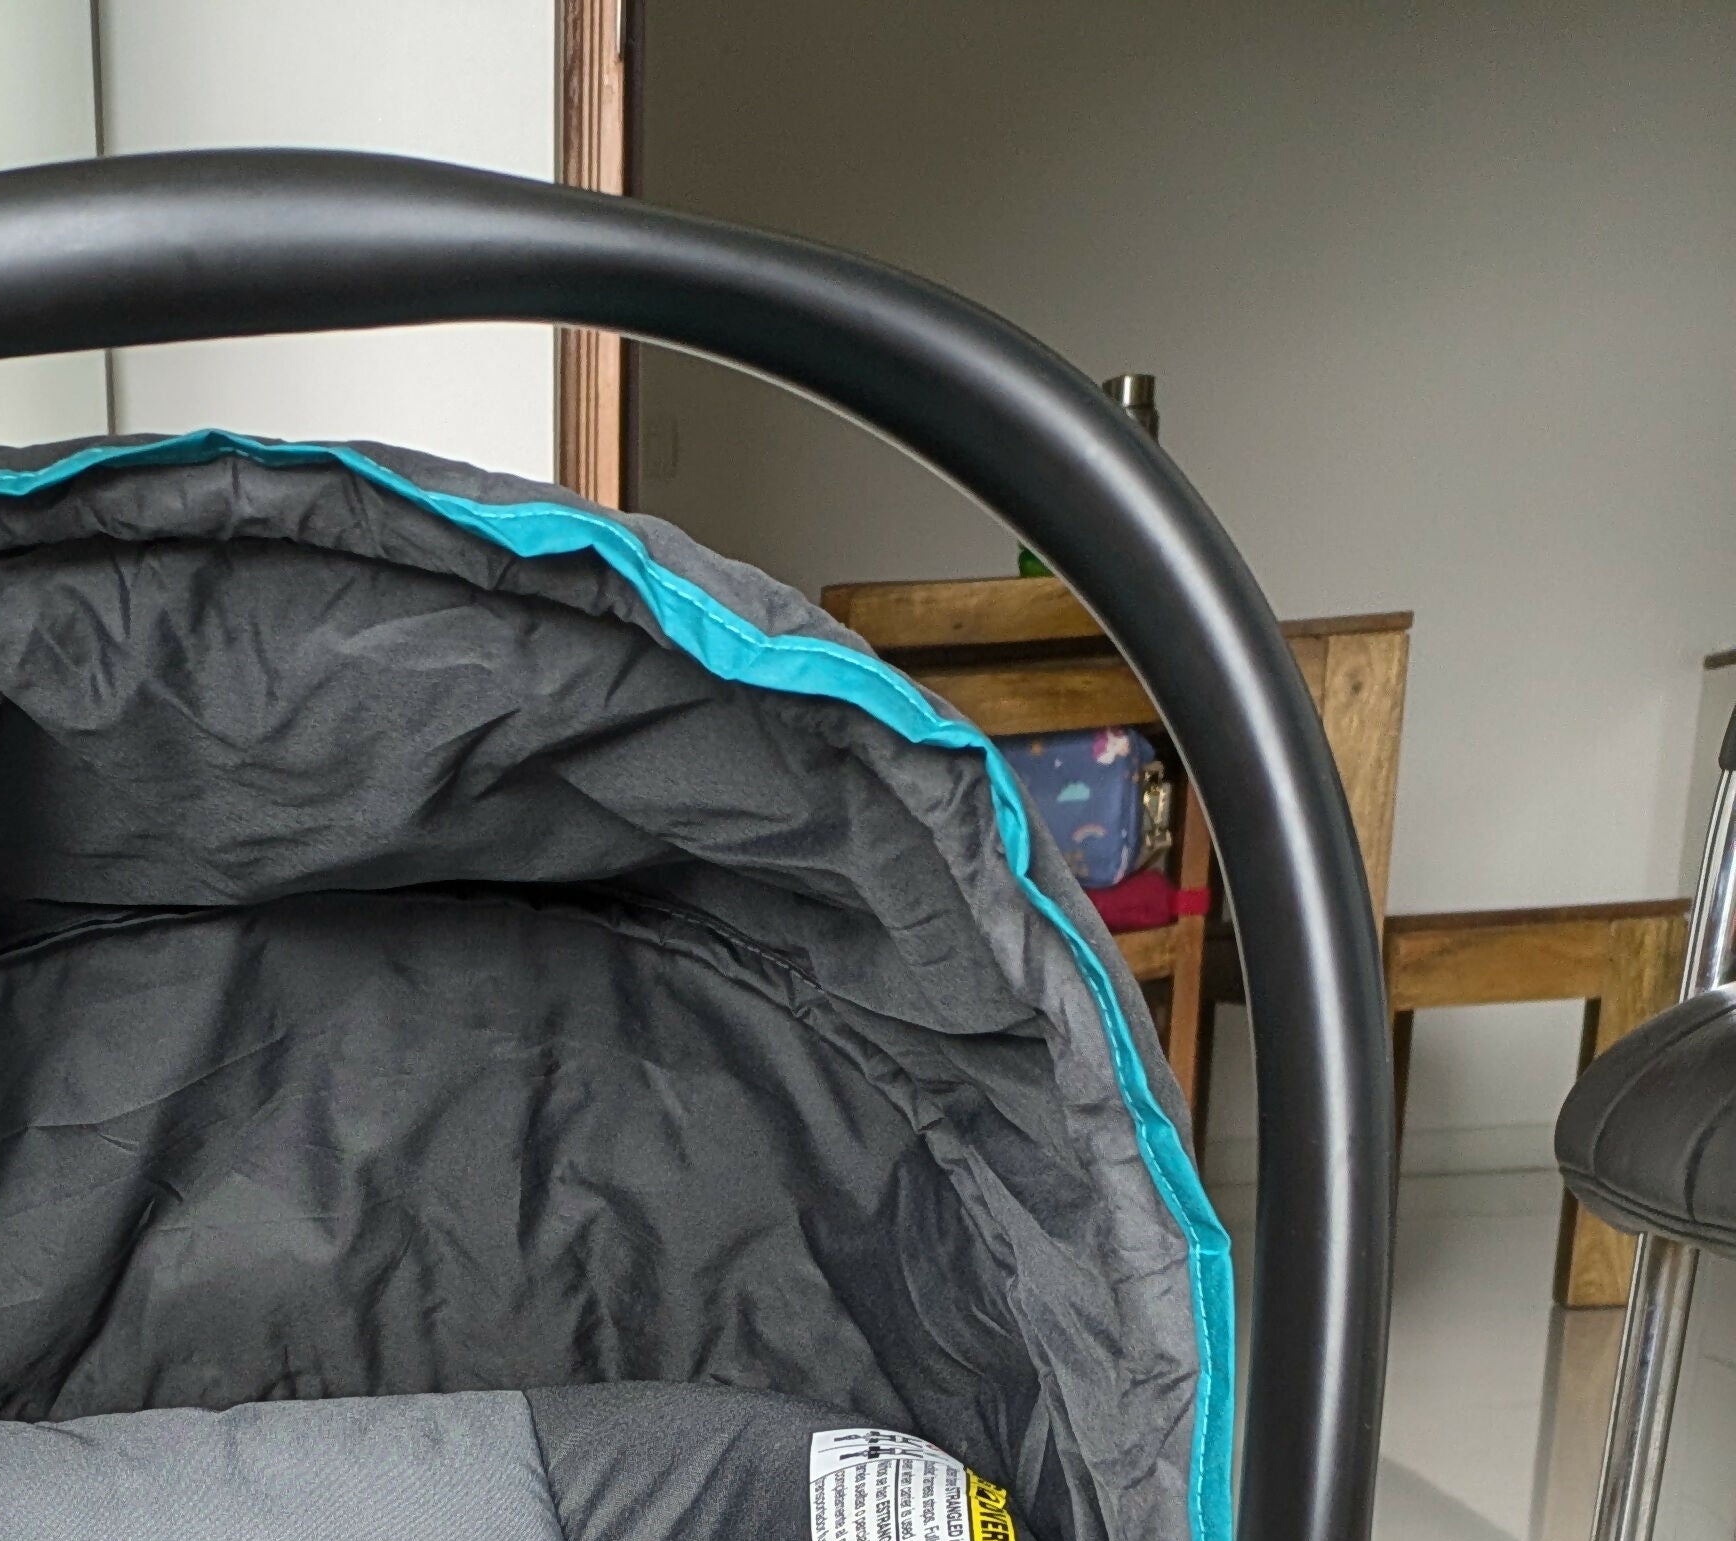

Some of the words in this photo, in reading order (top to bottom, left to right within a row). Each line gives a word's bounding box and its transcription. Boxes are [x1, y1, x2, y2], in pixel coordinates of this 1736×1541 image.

[901, 1508, 915, 1517] is
[920, 1498, 936, 1526] straps.
[946, 1487, 964, 1537] STRANGLED
[835, 1529, 848, 1540] al
[903, 1518, 917, 1540] used
